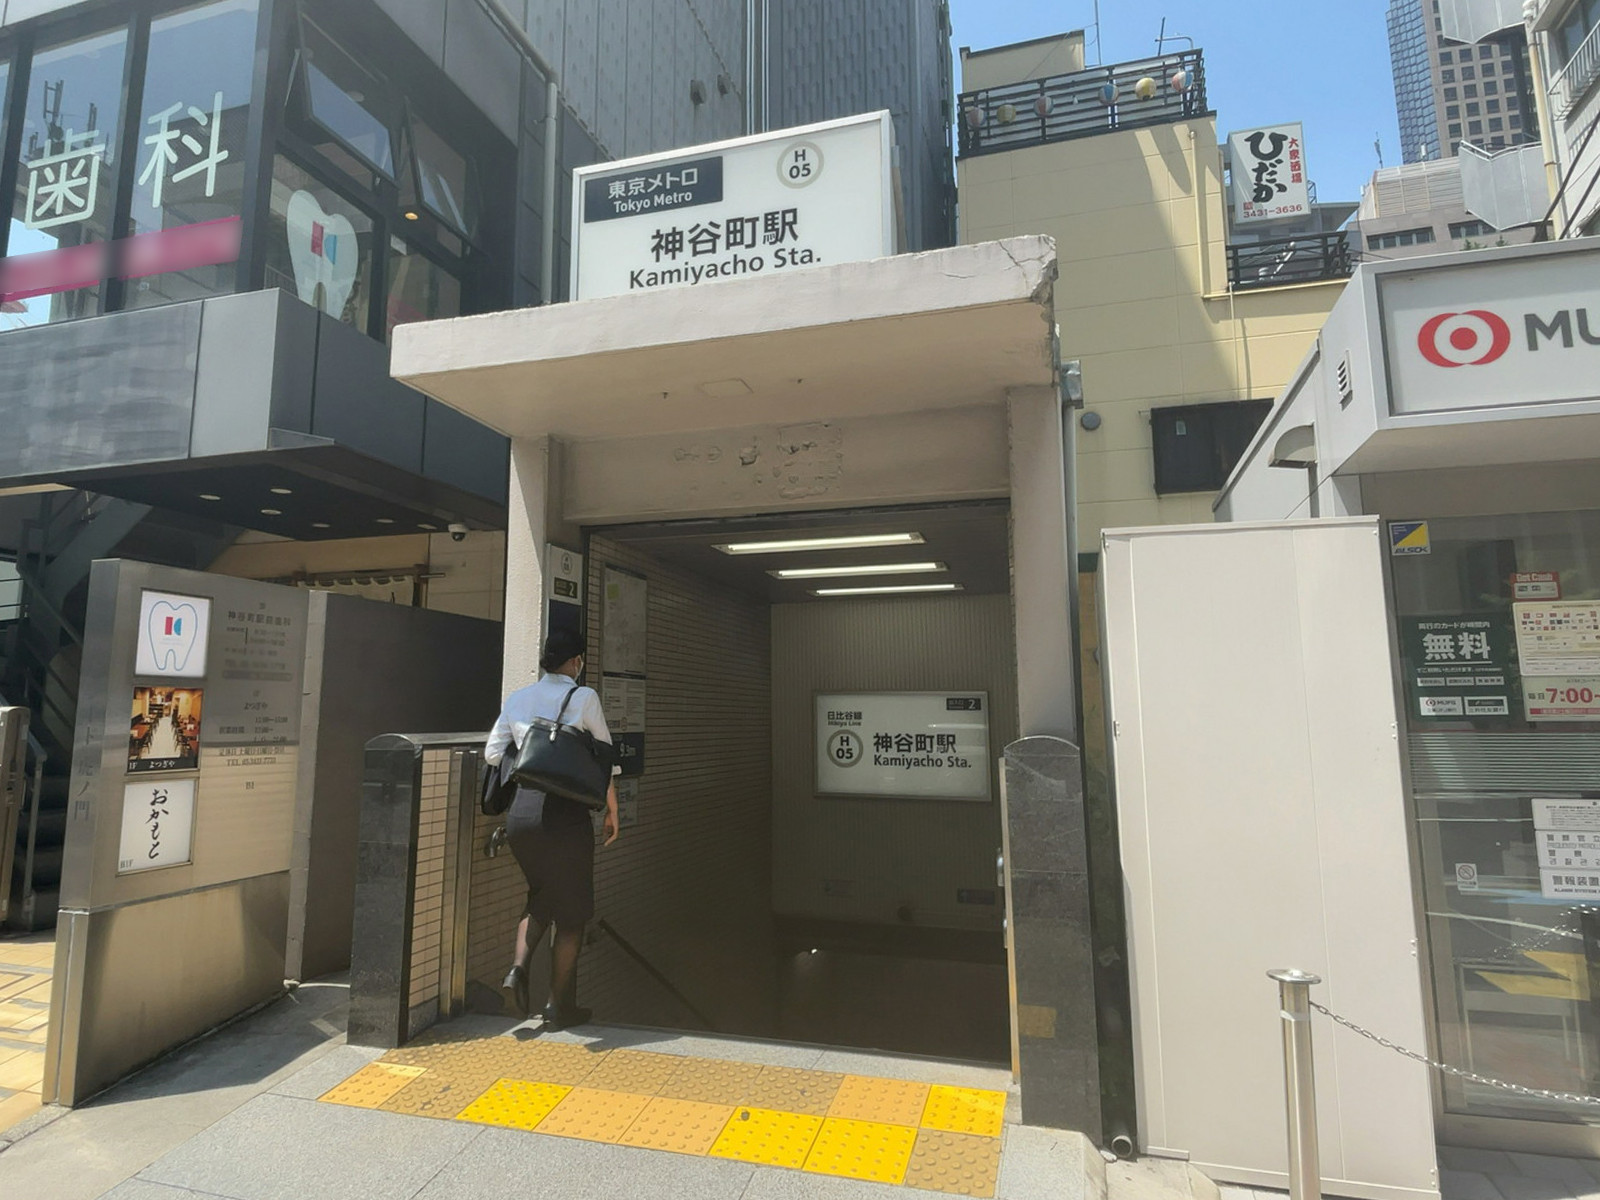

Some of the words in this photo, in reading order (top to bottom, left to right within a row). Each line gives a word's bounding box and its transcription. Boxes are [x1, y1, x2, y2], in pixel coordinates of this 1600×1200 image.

[25, 91, 230, 231] 歯科
[794, 149, 806, 163] H
[789, 162, 811, 180] 05
[1244, 131, 1288, 203] ひだか
[607, 167, 698, 200] 東京メトロ
[613, 196, 651, 214] Tokyo
[653, 190, 693, 207] Metro
[1243, 205, 1303, 219] 3431-3636
[650, 208, 800, 263] 神谷町駅
[629, 253, 765, 290] Kamiyacho
[773, 247, 822, 269] Sta.
[568, 582, 575, 597] 2
[1422, 631, 1491, 660] 無料
[968, 700, 976, 710] 2
[828, 711, 862, 721] 日比谷線
[828, 720, 847, 728] Hibiya
[840, 736, 850, 747] H
[873, 732, 957, 754] 神谷町駅
[836, 748, 853, 760] 05
[873, 754, 943, 770] Kamiyacho
[947, 755, 972, 768] Sta.
[149, 759, 176, 769] よつぎや
[145, 788, 169, 859] おかもと
